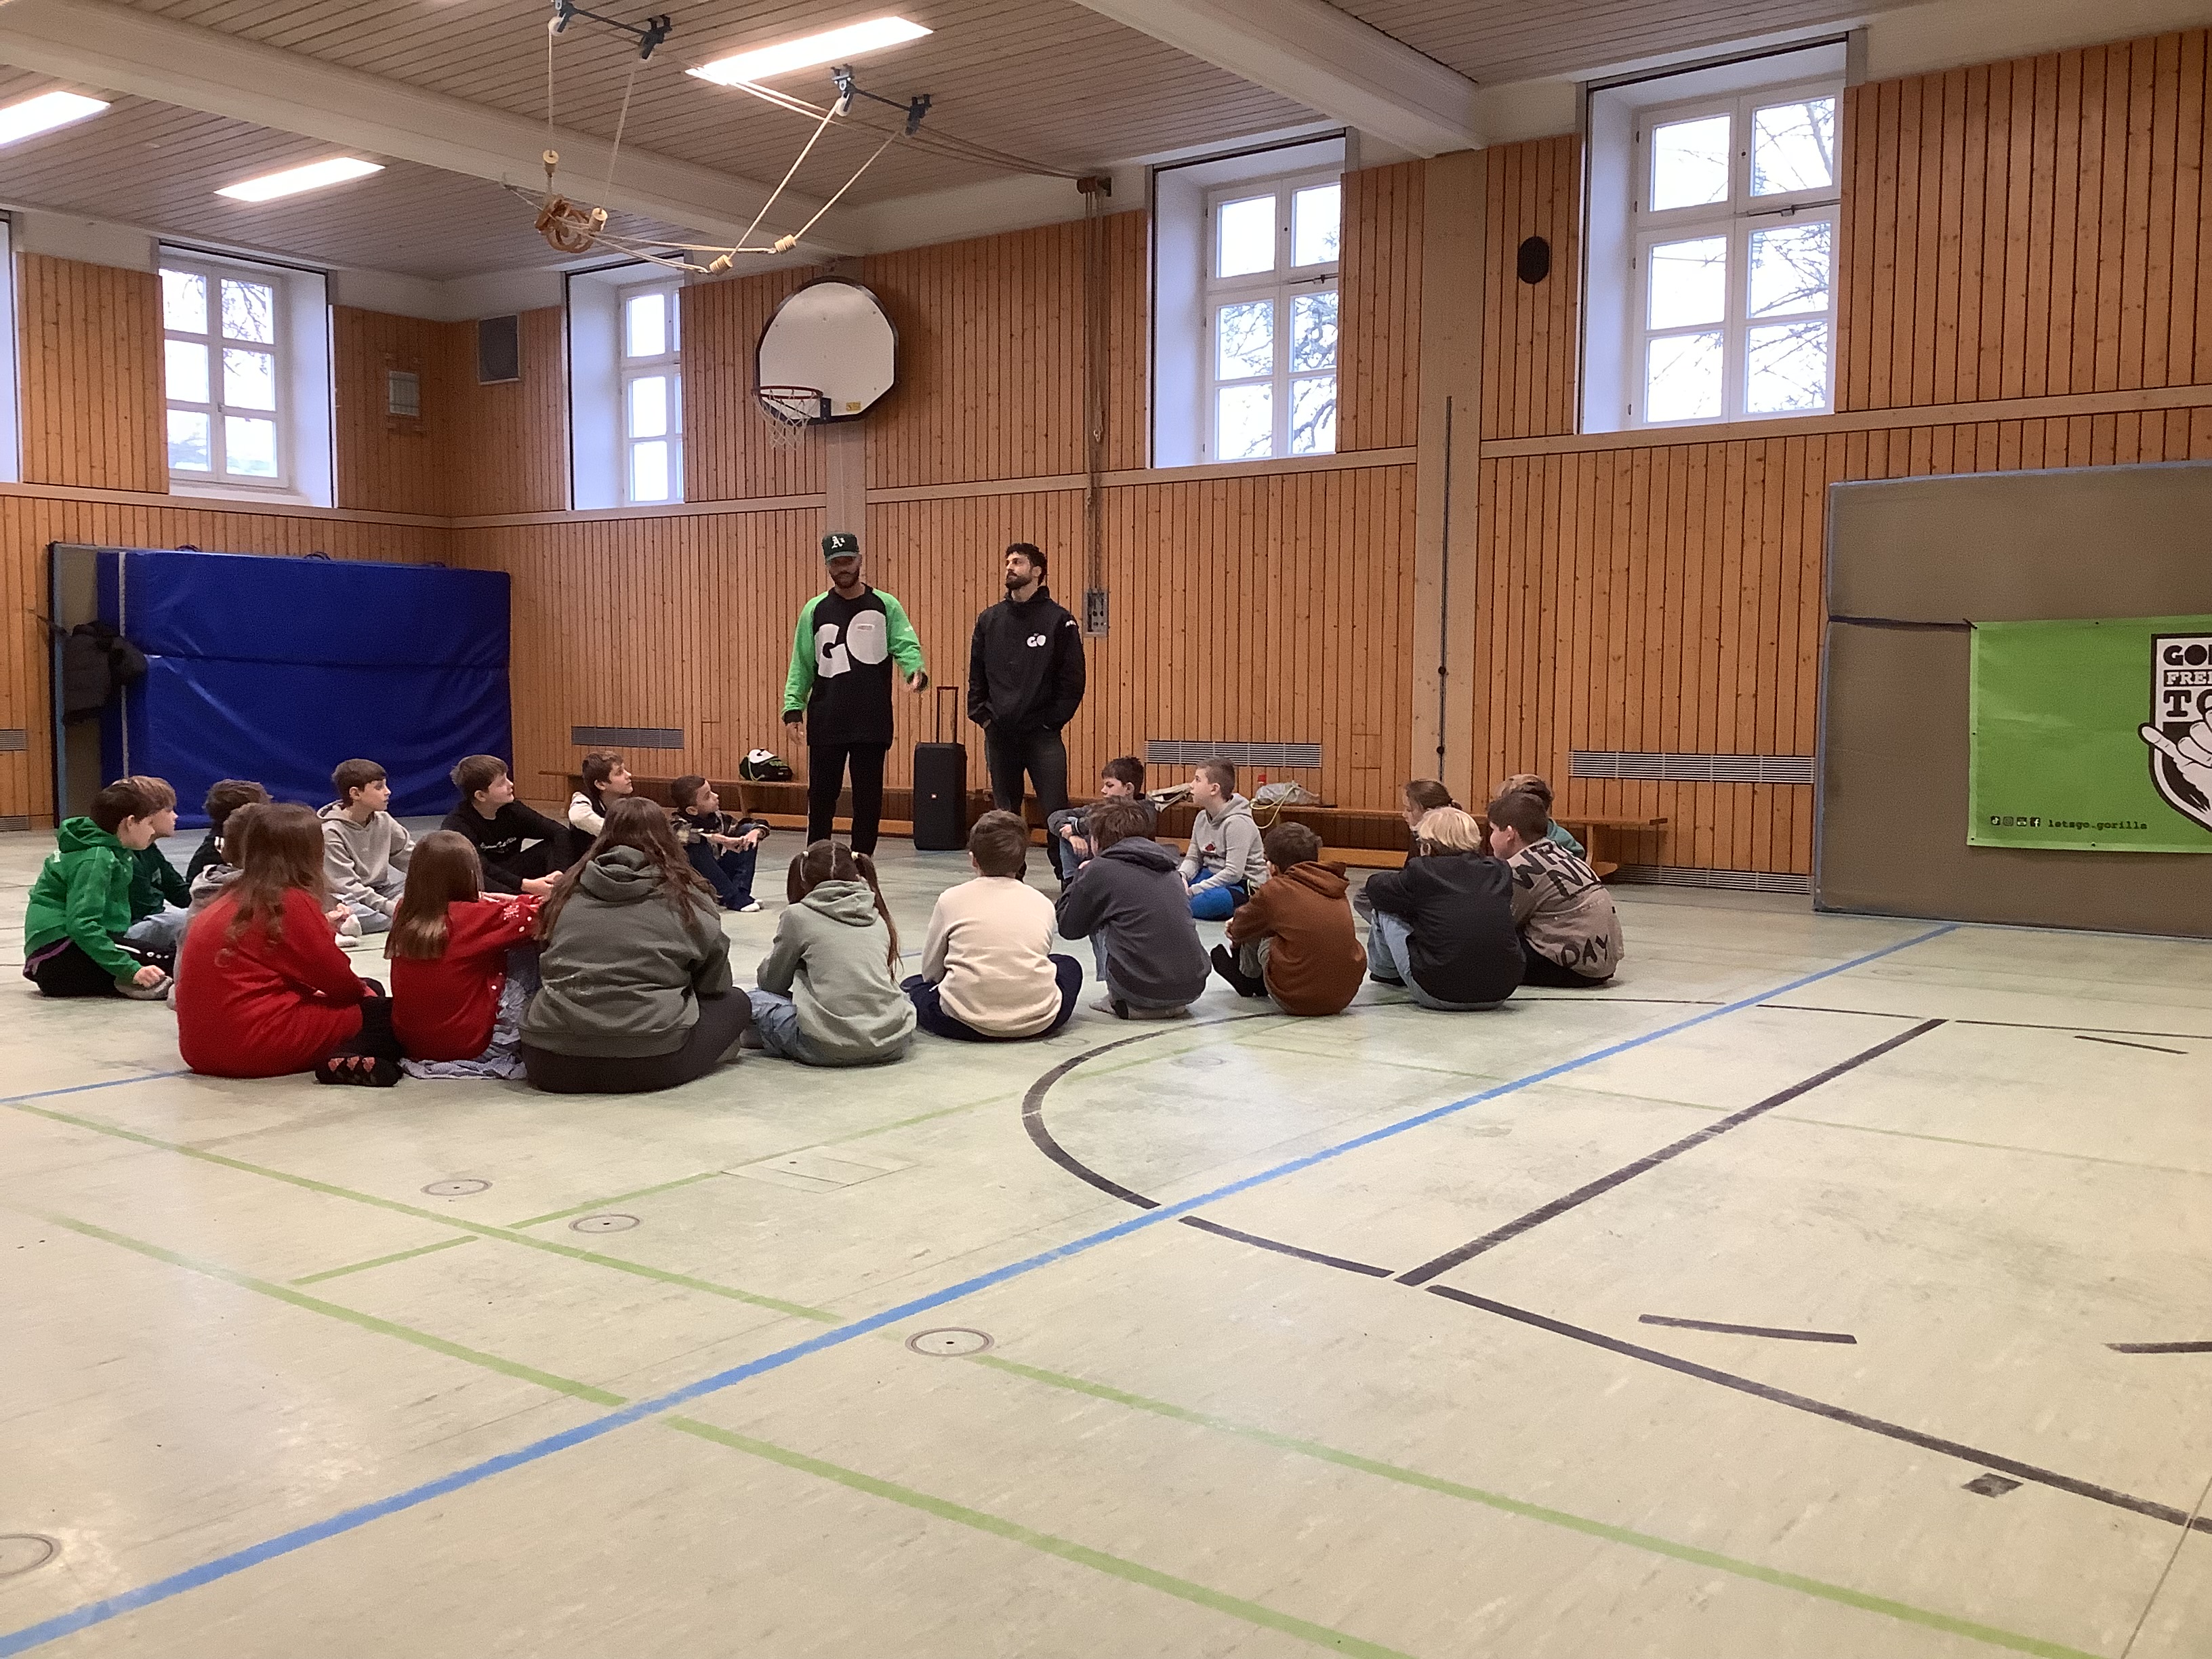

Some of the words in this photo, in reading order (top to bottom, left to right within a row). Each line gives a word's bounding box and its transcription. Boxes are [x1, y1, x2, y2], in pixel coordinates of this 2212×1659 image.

[815, 610, 888, 678] GO
[1027, 634, 1046, 647] GO
[2163, 644, 2212, 665] GO
[2048, 819, 2147, 830] letsgo.gorilla
